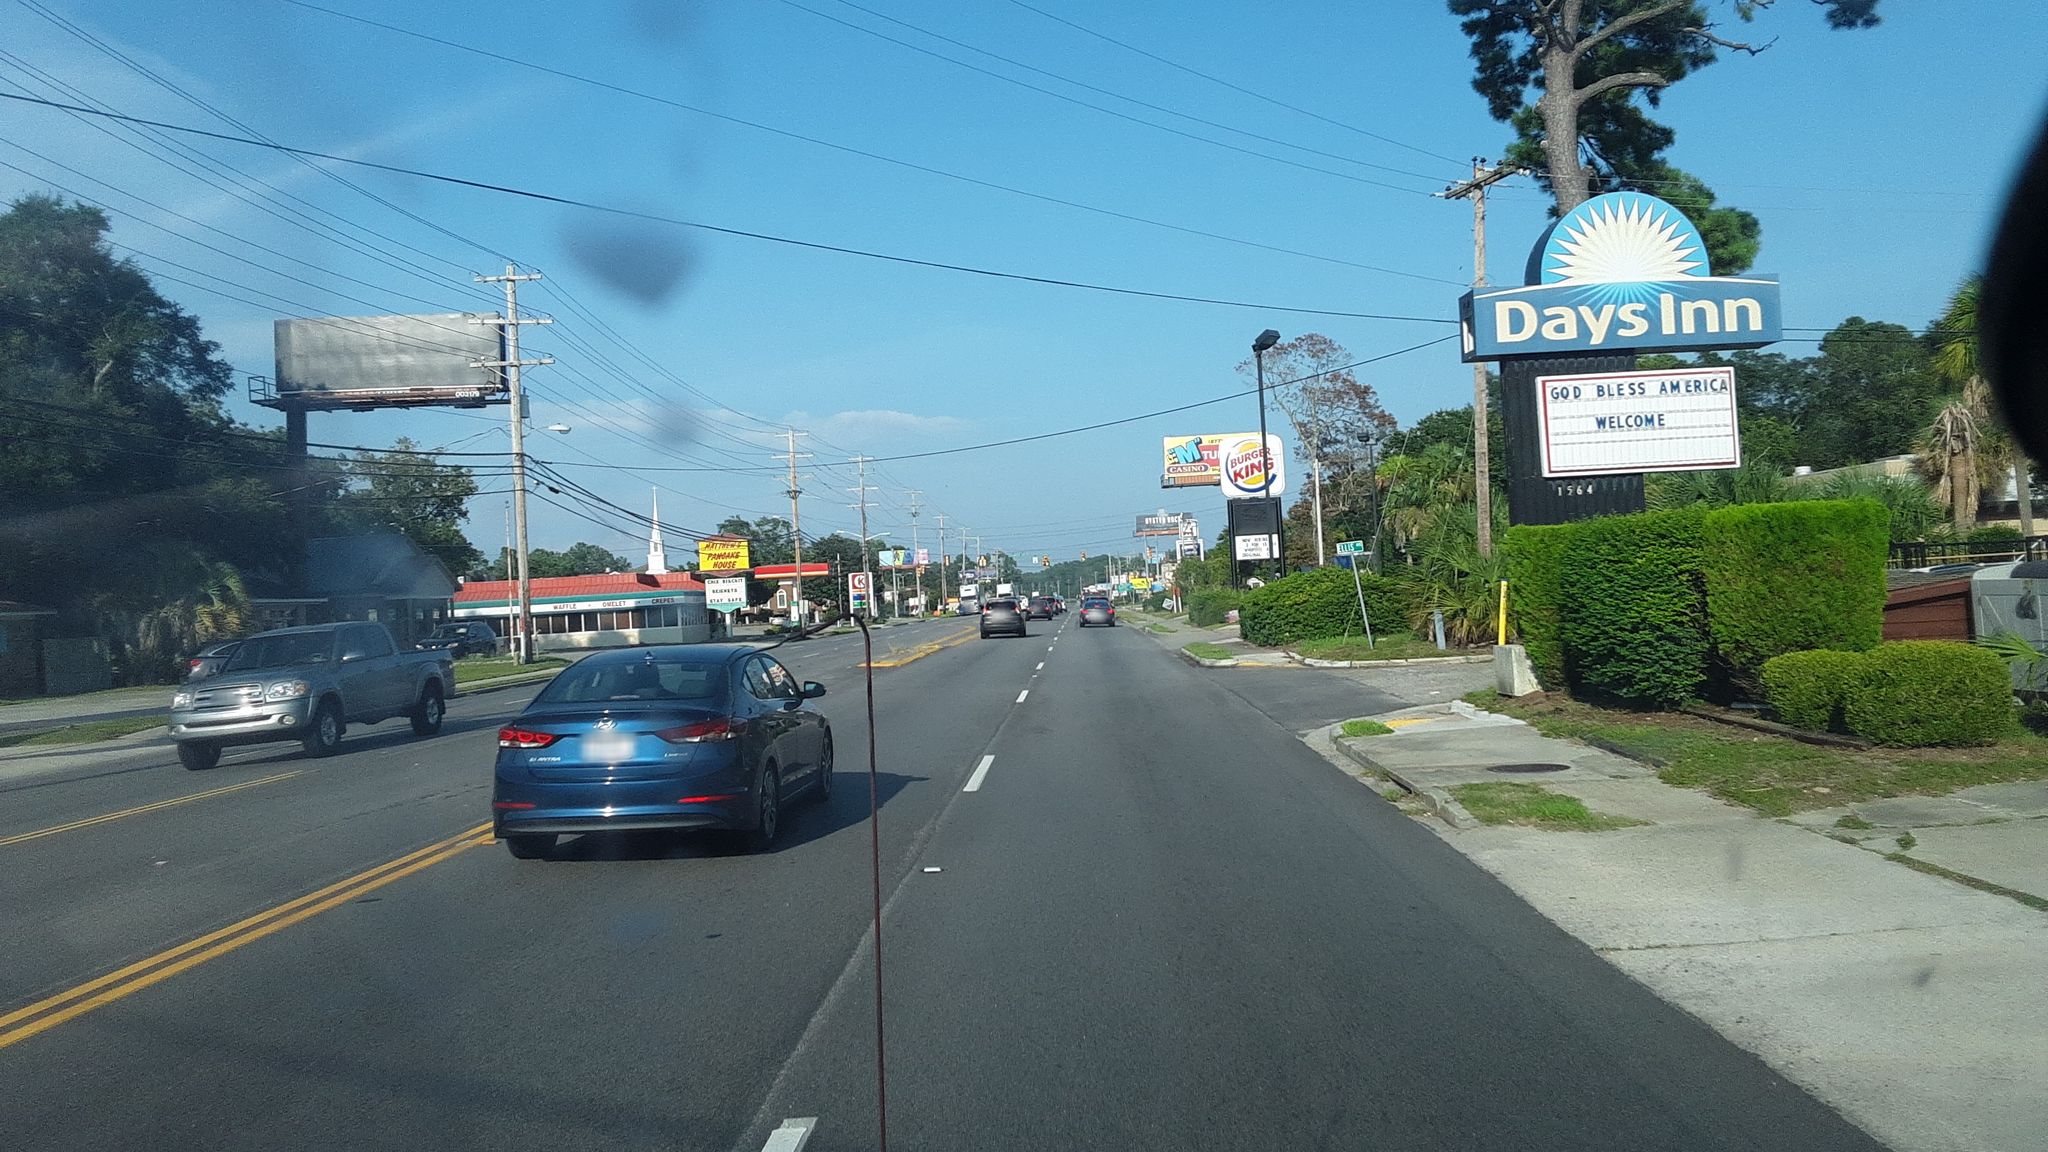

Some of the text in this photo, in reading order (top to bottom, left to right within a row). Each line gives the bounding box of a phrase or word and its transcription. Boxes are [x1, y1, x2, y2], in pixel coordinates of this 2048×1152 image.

[1495, 293, 1763, 345] Days Inn
[1550, 377, 1728, 400] GOD BLESS AMERICA
[1595, 413, 1666, 430] WELCOME
[1230, 447, 1271, 469] BURGER
[1169, 465, 1205, 473] CASINO
[1233, 458, 1274, 483] KING
[1557, 483, 1593, 497] 1564
[1337, 543, 1355, 553] ELLIS
[706, 551, 740, 560] PANCAKE
[713, 560, 737, 569] HOUSE
[553, 602, 577, 610] WAFFLE
